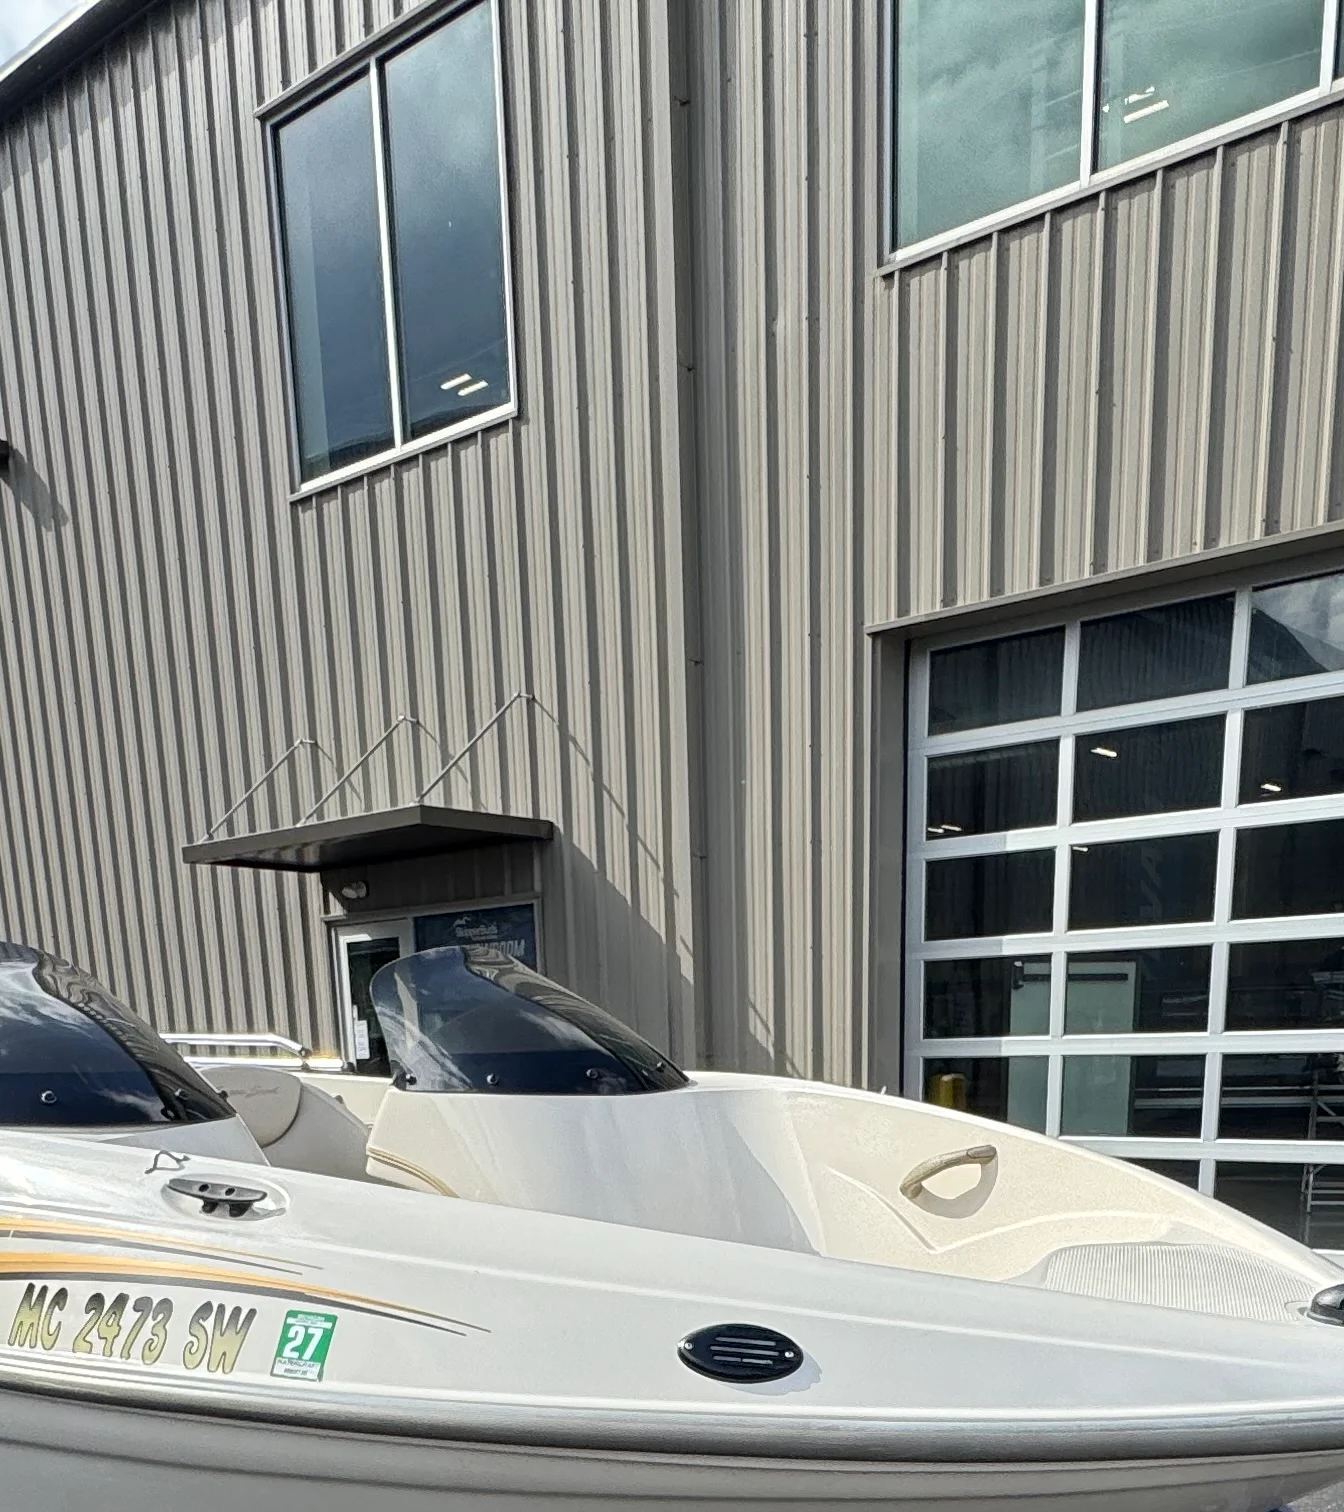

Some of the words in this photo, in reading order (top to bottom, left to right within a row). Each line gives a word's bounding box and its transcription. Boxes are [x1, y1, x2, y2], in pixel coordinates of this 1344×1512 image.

[8, 1282, 68, 1351] MC
[72, 1292, 173, 1364] 2473
[182, 1300, 257, 1375] SW
[282, 1325, 324, 1361] 27
